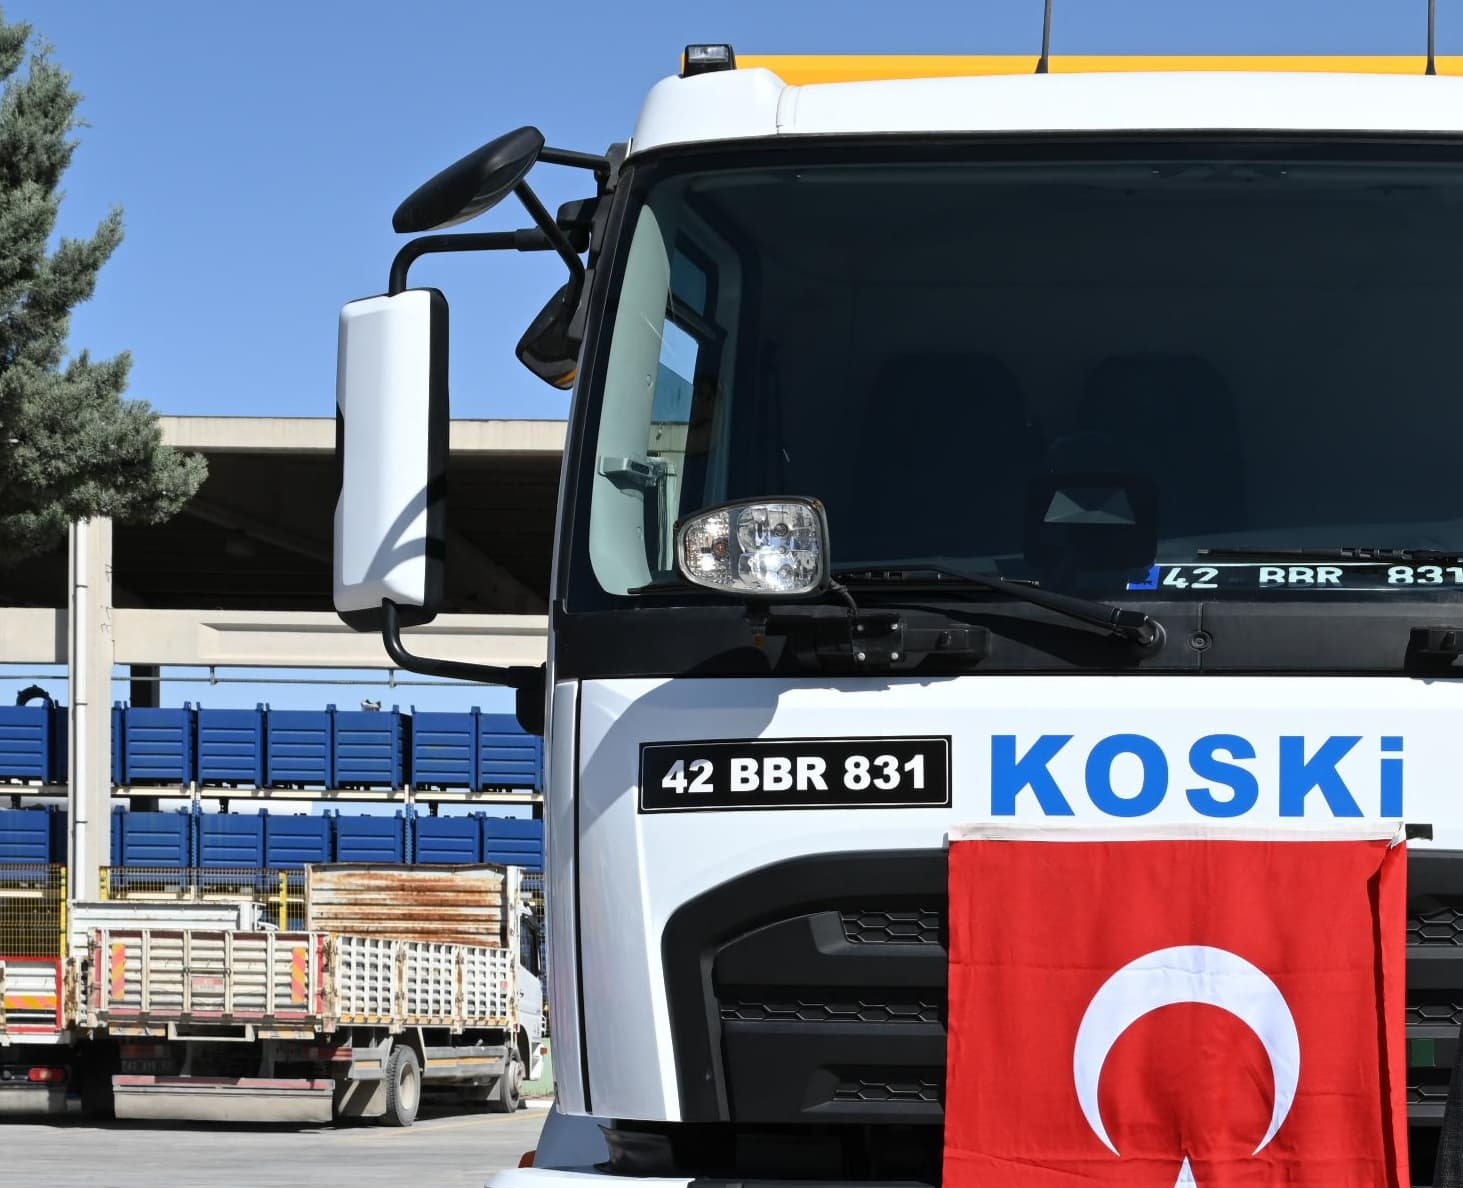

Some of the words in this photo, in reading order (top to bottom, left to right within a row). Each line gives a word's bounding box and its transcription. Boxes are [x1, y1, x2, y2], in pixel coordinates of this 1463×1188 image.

[1163, 567, 1219, 589] 42
[661, 759, 714, 794] 42
[730, 756, 829, 792] BBR
[843, 754, 925, 791] 831
